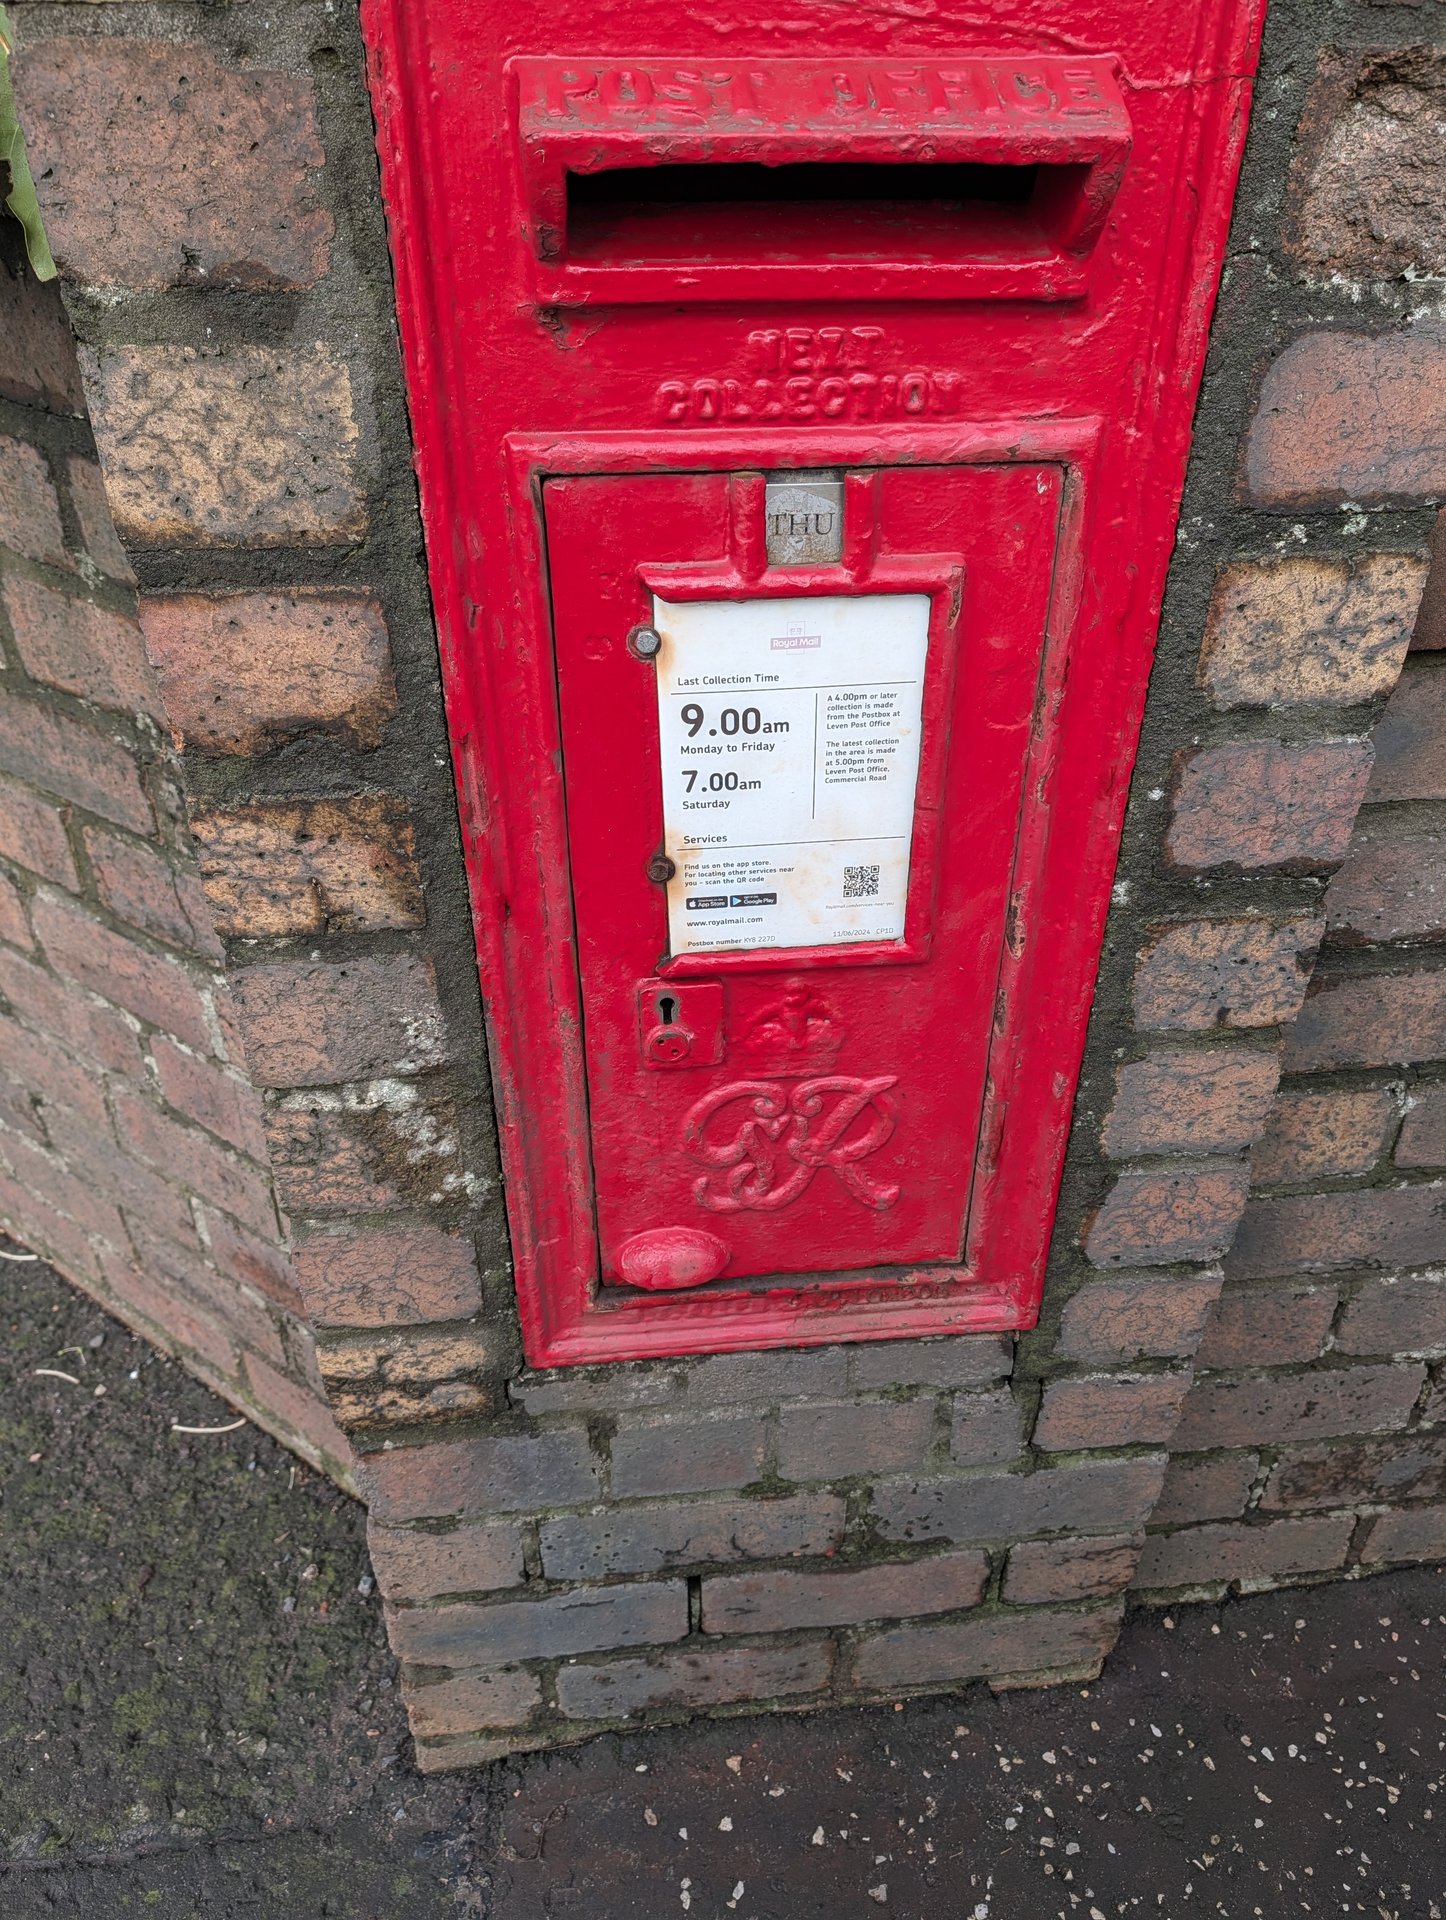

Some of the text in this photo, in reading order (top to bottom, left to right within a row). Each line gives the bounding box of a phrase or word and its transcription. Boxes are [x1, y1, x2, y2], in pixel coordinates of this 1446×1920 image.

[545, 67, 1114, 117] POST OFFICE
[656, 373, 964, 420] COLLECTION
[768, 511, 835, 535] THU
[773, 637, 819, 648] Royal Mail
[677, 673, 780, 686] Last Collection Time
[835, 693, 867, 702] 4.00pm
[827, 703, 862, 711] collection
[680, 703, 790, 738] 9.00am
[865, 738, 899, 746] collection
[680, 742, 775, 756] Monday to Friday
[835, 758, 864, 766] 5.00pm
[681, 770, 761, 793] 7.00am
[825, 776, 866, 784] Commercial
[682, 800, 731, 810] Saturday
[684, 834, 728, 844] Services
[687, 917, 763, 927] www.royalmail.com
[833, 929, 870, 937] 11/06/2024
[688, 939, 714, 947] Postbox
